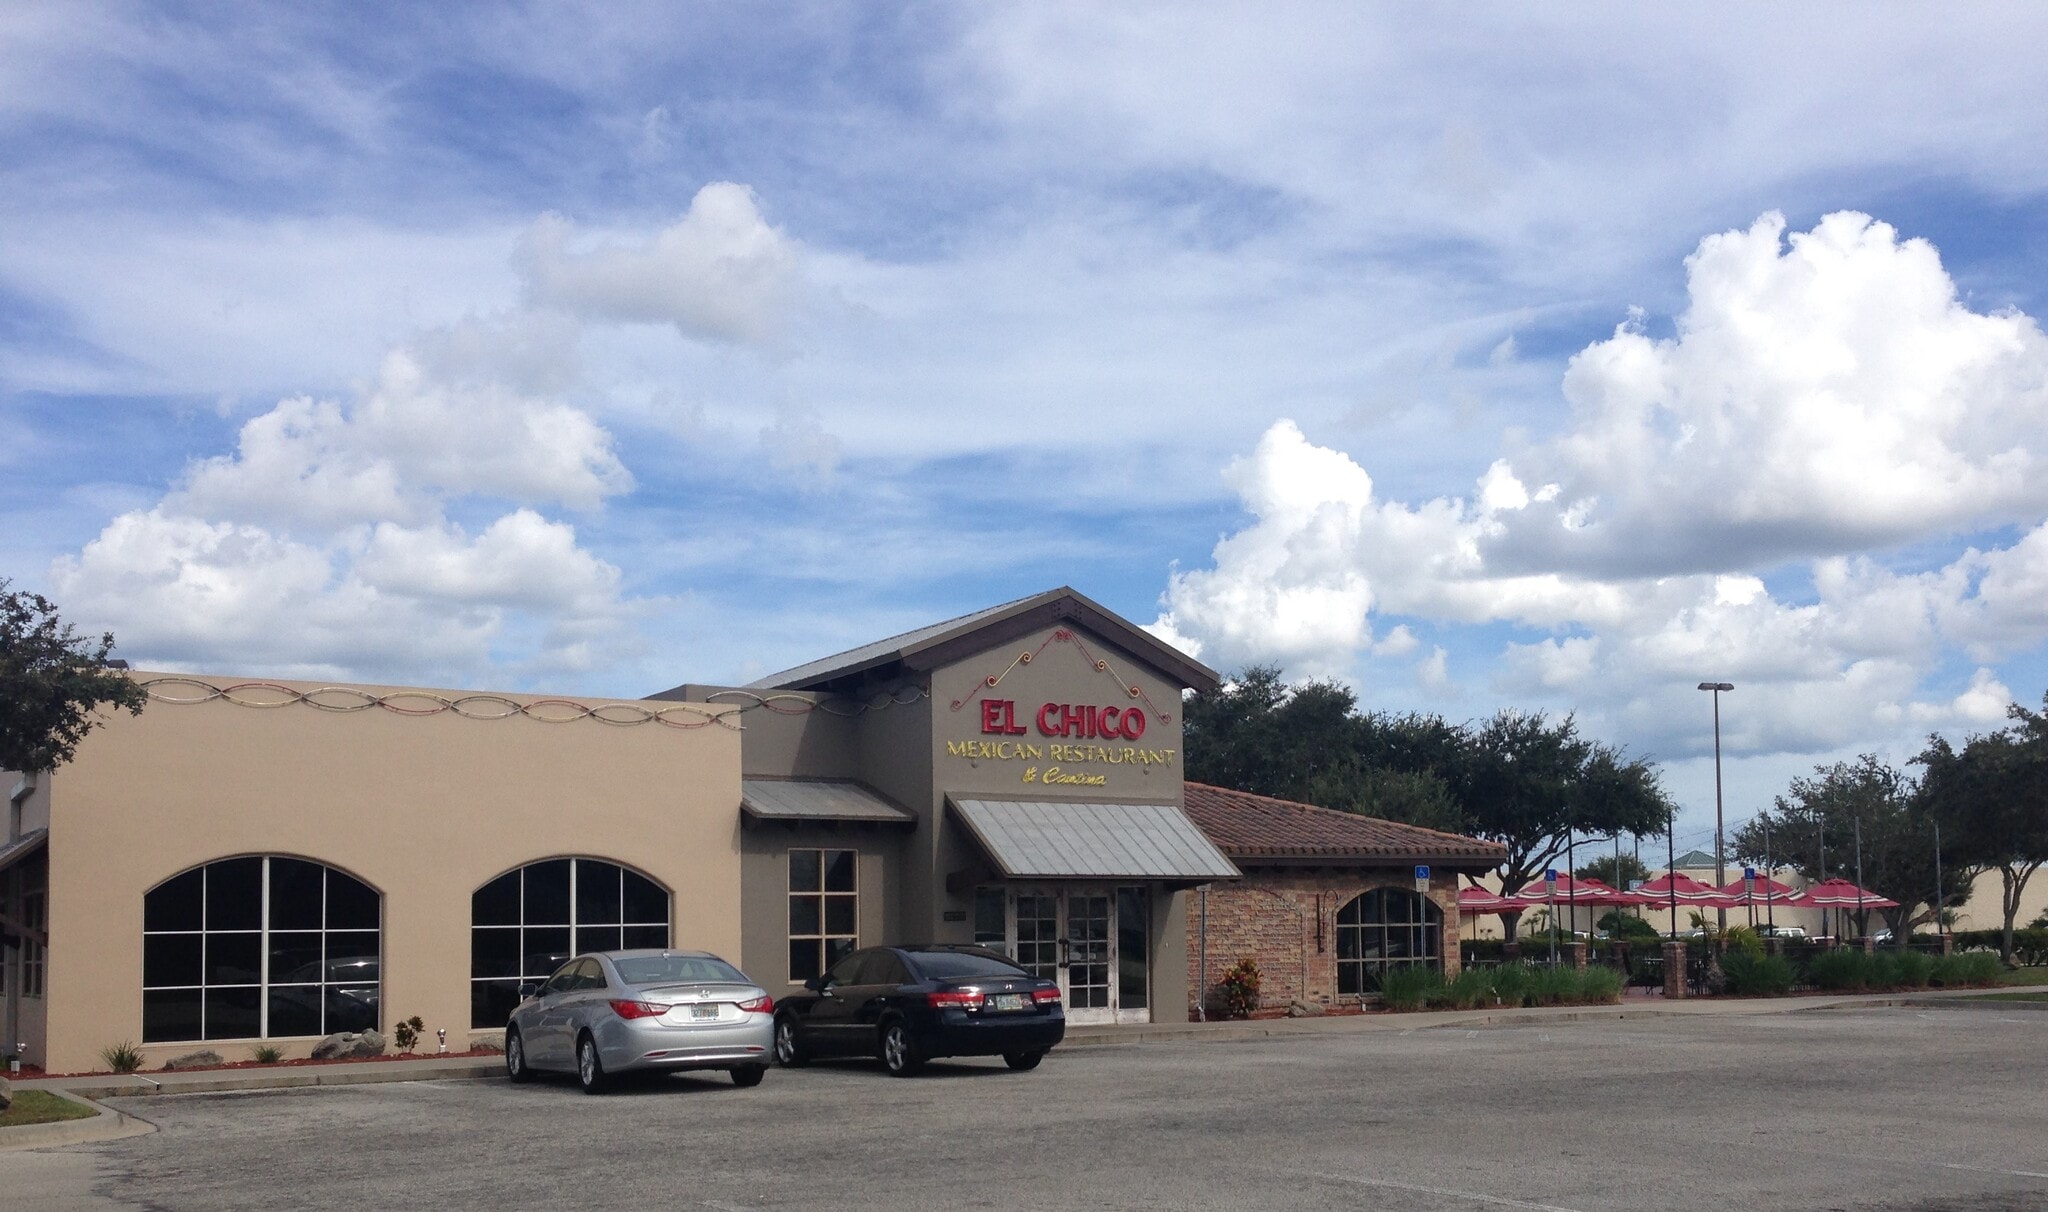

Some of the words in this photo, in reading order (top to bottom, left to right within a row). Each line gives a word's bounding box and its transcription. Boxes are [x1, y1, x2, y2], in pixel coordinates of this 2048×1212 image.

[981, 699, 1027, 736] EL
[1036, 702, 1146, 741] CHICO
[946, 740, 1043, 760] MEXICAN
[1050, 744, 1176, 767] RESTAURANT
[1042, 766, 1107, 787] Cantina
